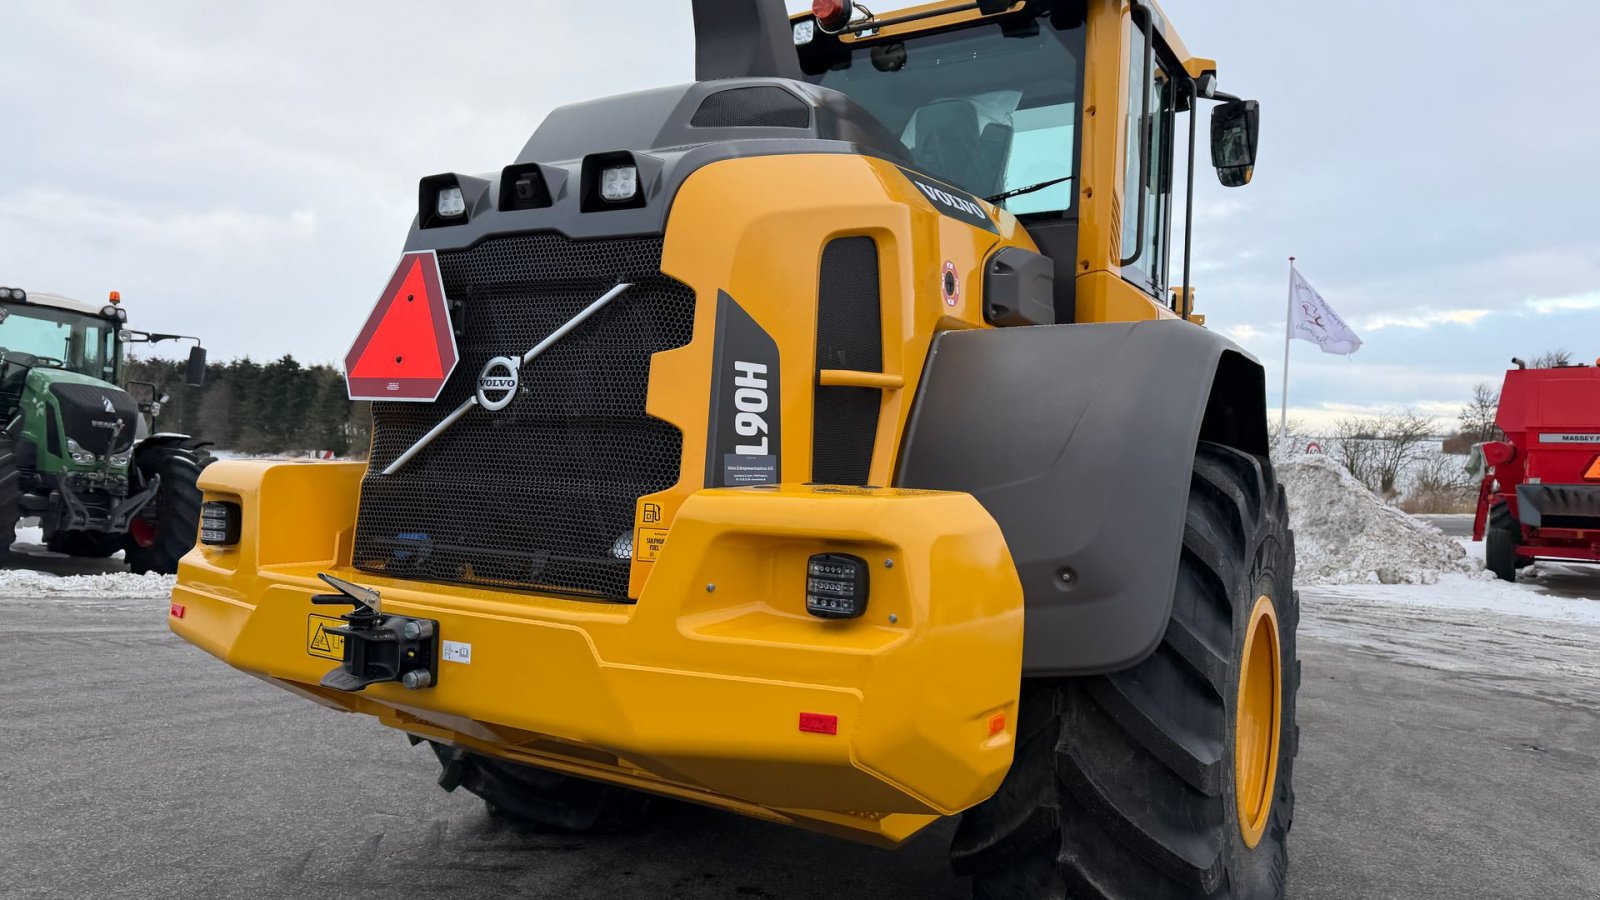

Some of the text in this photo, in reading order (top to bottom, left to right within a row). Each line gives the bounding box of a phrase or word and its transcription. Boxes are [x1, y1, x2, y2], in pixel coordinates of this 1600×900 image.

[914, 180, 986, 219] VOLVO
[479, 379, 516, 388] VOLVO
[734, 360, 769, 456] L90H
